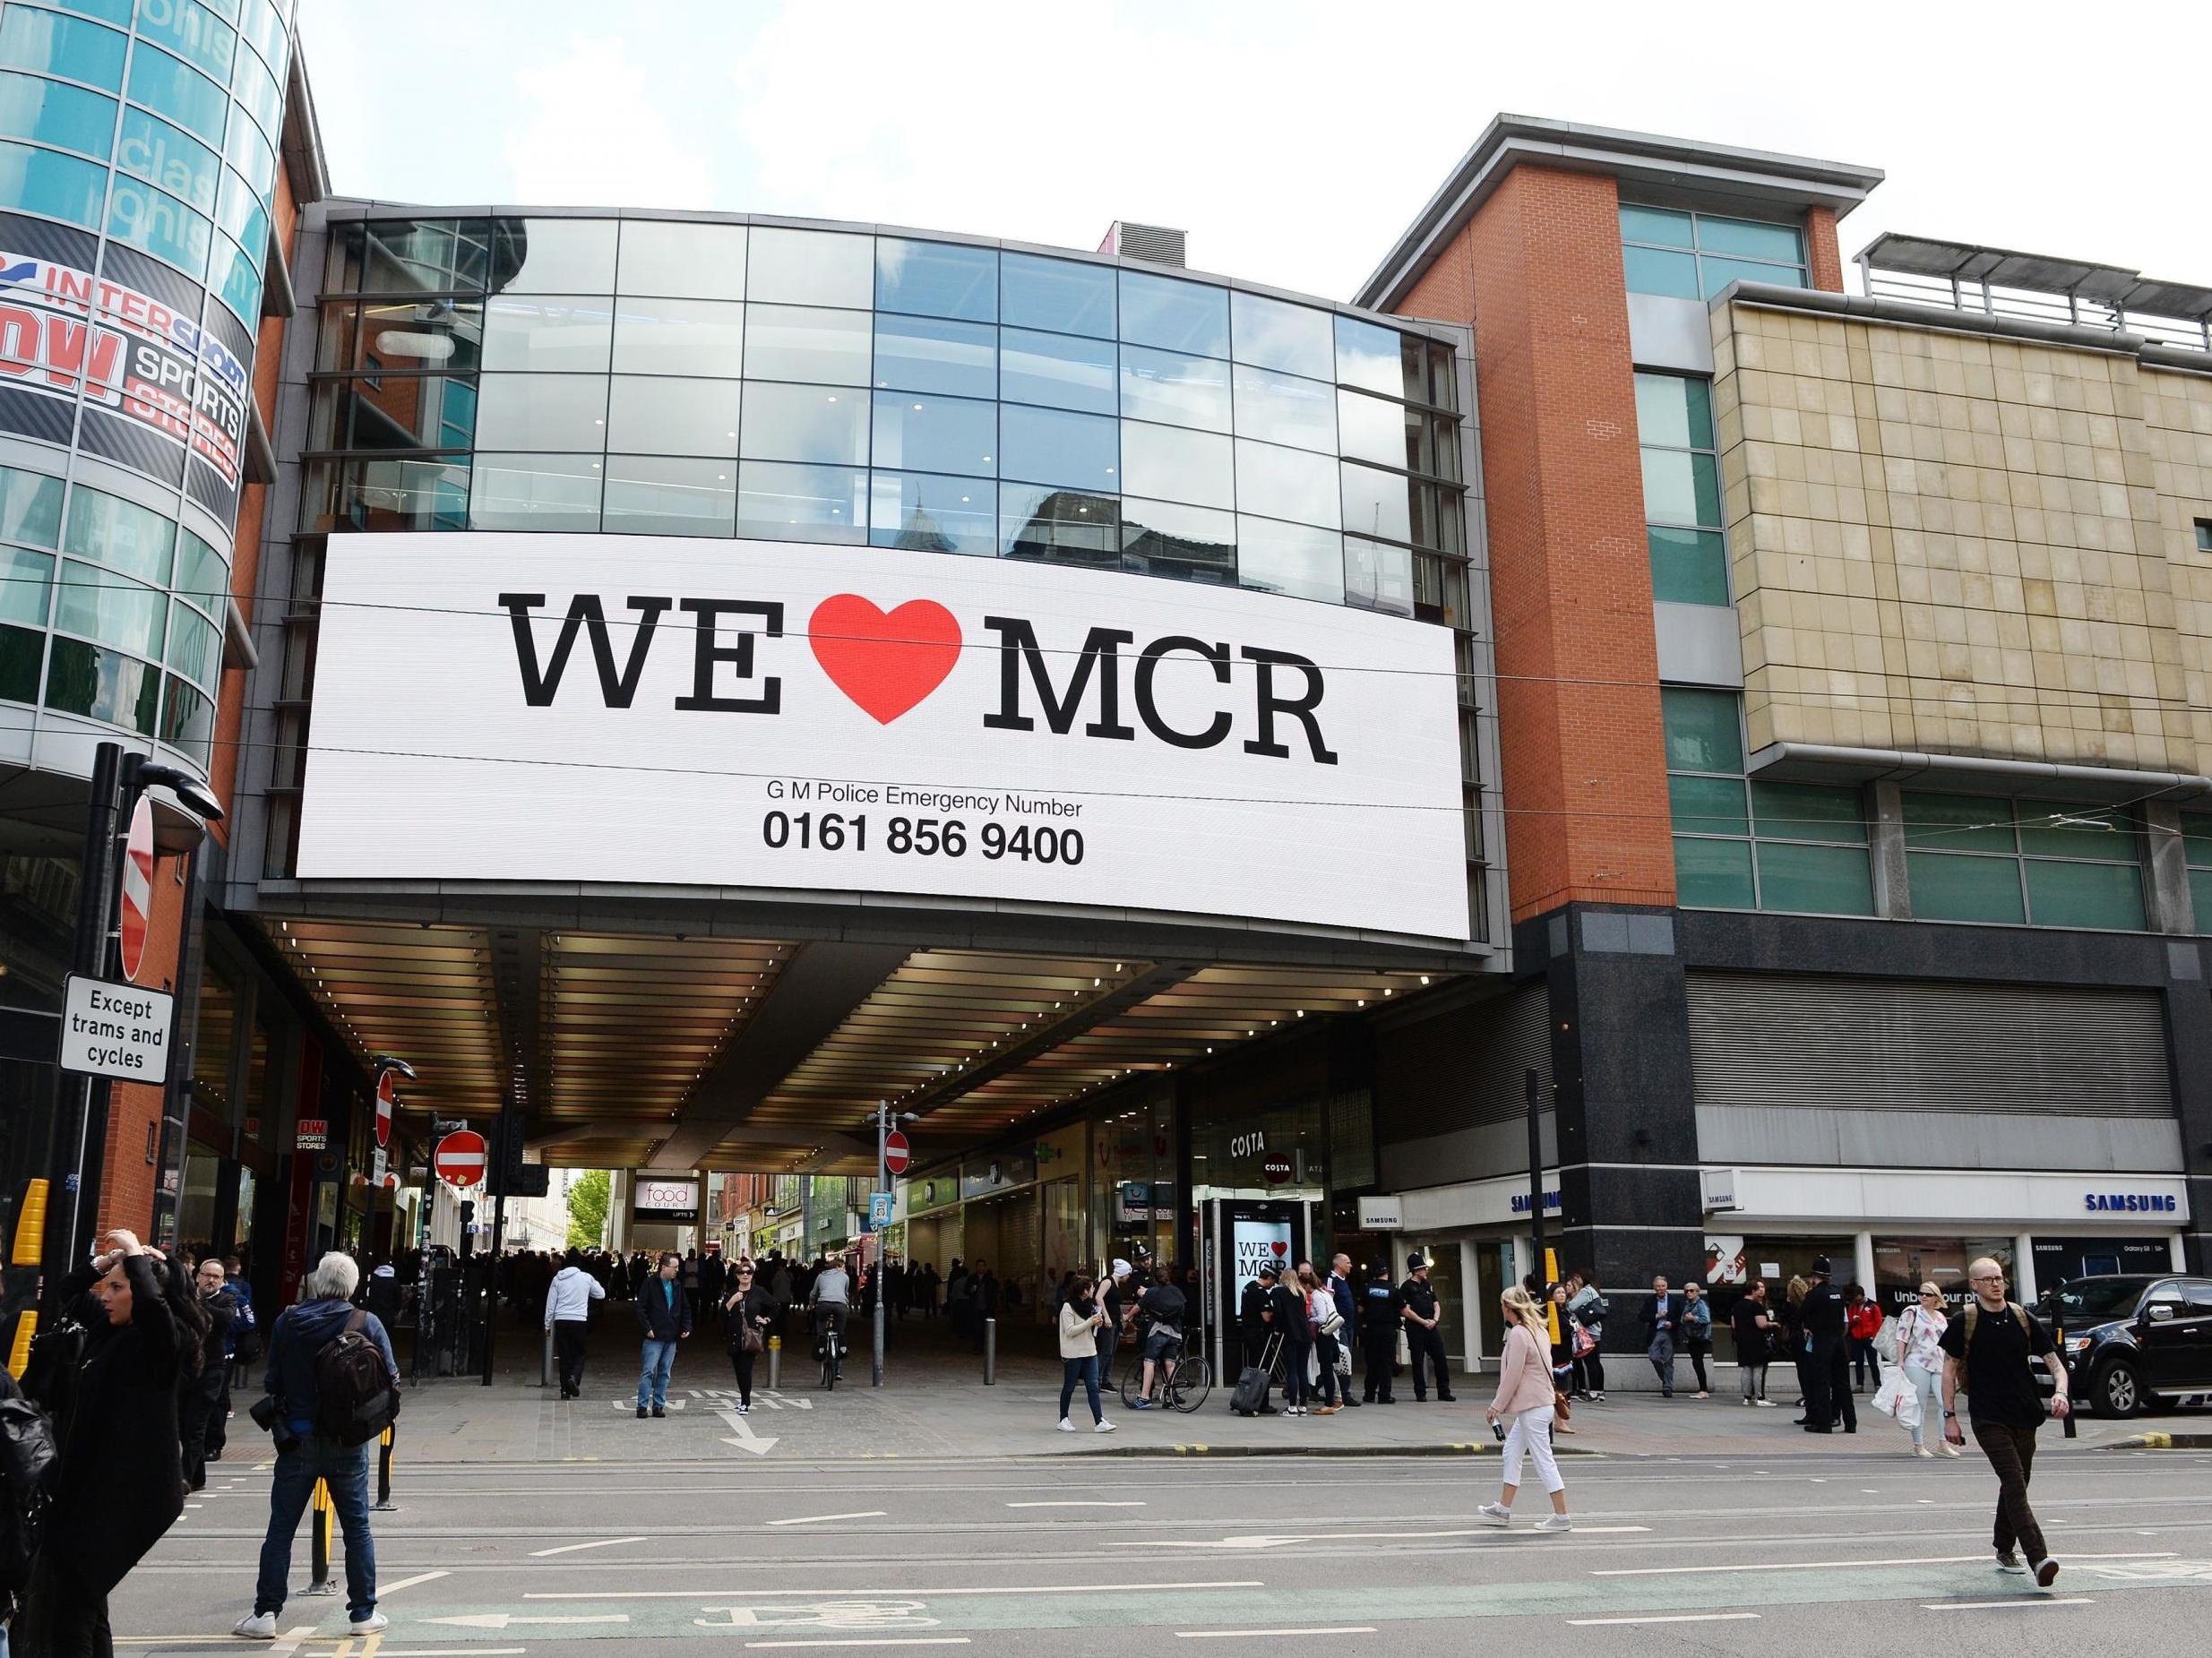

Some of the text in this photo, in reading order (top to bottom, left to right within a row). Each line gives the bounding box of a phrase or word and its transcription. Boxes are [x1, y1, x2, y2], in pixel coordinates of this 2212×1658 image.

[44, 266, 245, 401] INTERSPORT
[135, 346, 240, 441] SPORTS
[133, 383, 237, 474] STORES
[498, 592, 1338, 766] WE MCR
[767, 780, 1083, 818] G M Police Emergency Number
[763, 810, 1085, 866] 0161 856 9400
[90, 989, 153, 1019] Except
[72, 1013, 163, 1046] trams and
[87, 1046, 143, 1069] cycles
[300, 1120, 326, 1135] DW
[297, 1142, 326, 1150] STORES
[1231, 1131, 1265, 1158] COSTA
[1265, 1164, 1290, 1172] COSTA
[646, 1183, 689, 1202] food
[1708, 1195, 1733, 1203] SAMSUNG
[2085, 1193, 2176, 1212] SAMSUNG
[1238, 1241, 1270, 1257] WE
[2123, 1245, 2143, 1253] Galaxy
